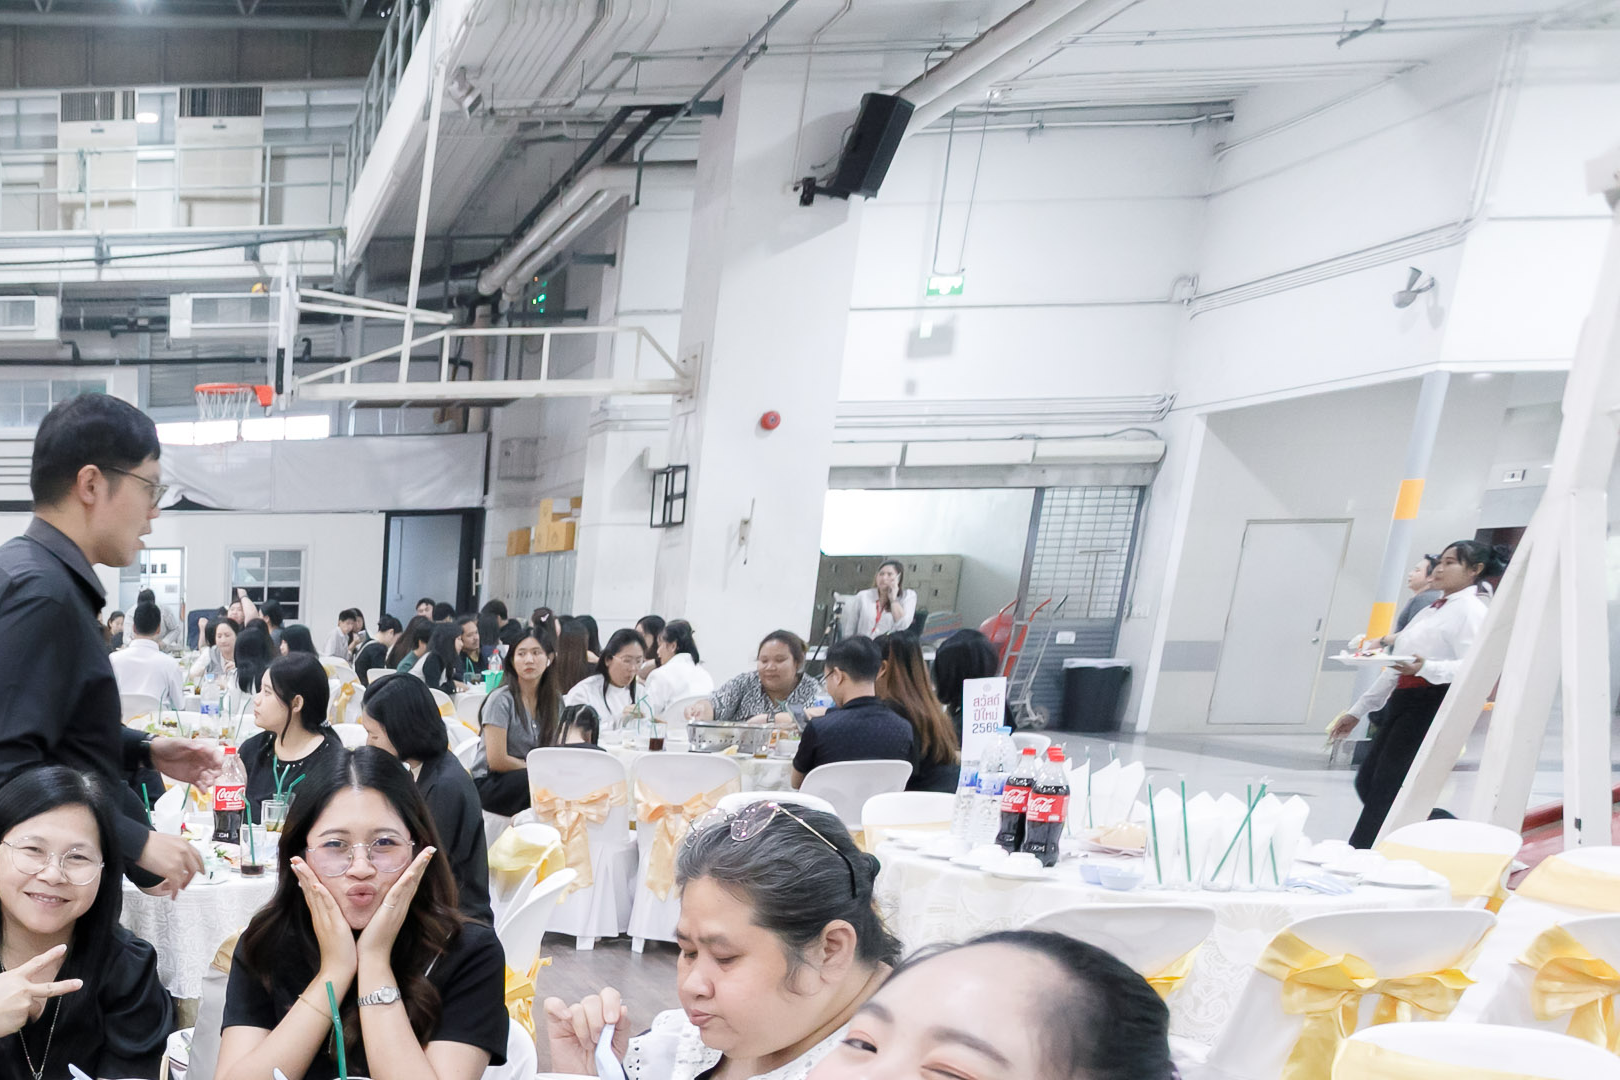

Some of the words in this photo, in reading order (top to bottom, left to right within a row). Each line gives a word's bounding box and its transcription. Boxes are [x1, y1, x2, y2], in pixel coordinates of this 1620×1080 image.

[973, 693, 1000, 707] สวัสดี
[974, 707, 998, 721] ปีใหม่
[972, 722, 999, 734] 2569
